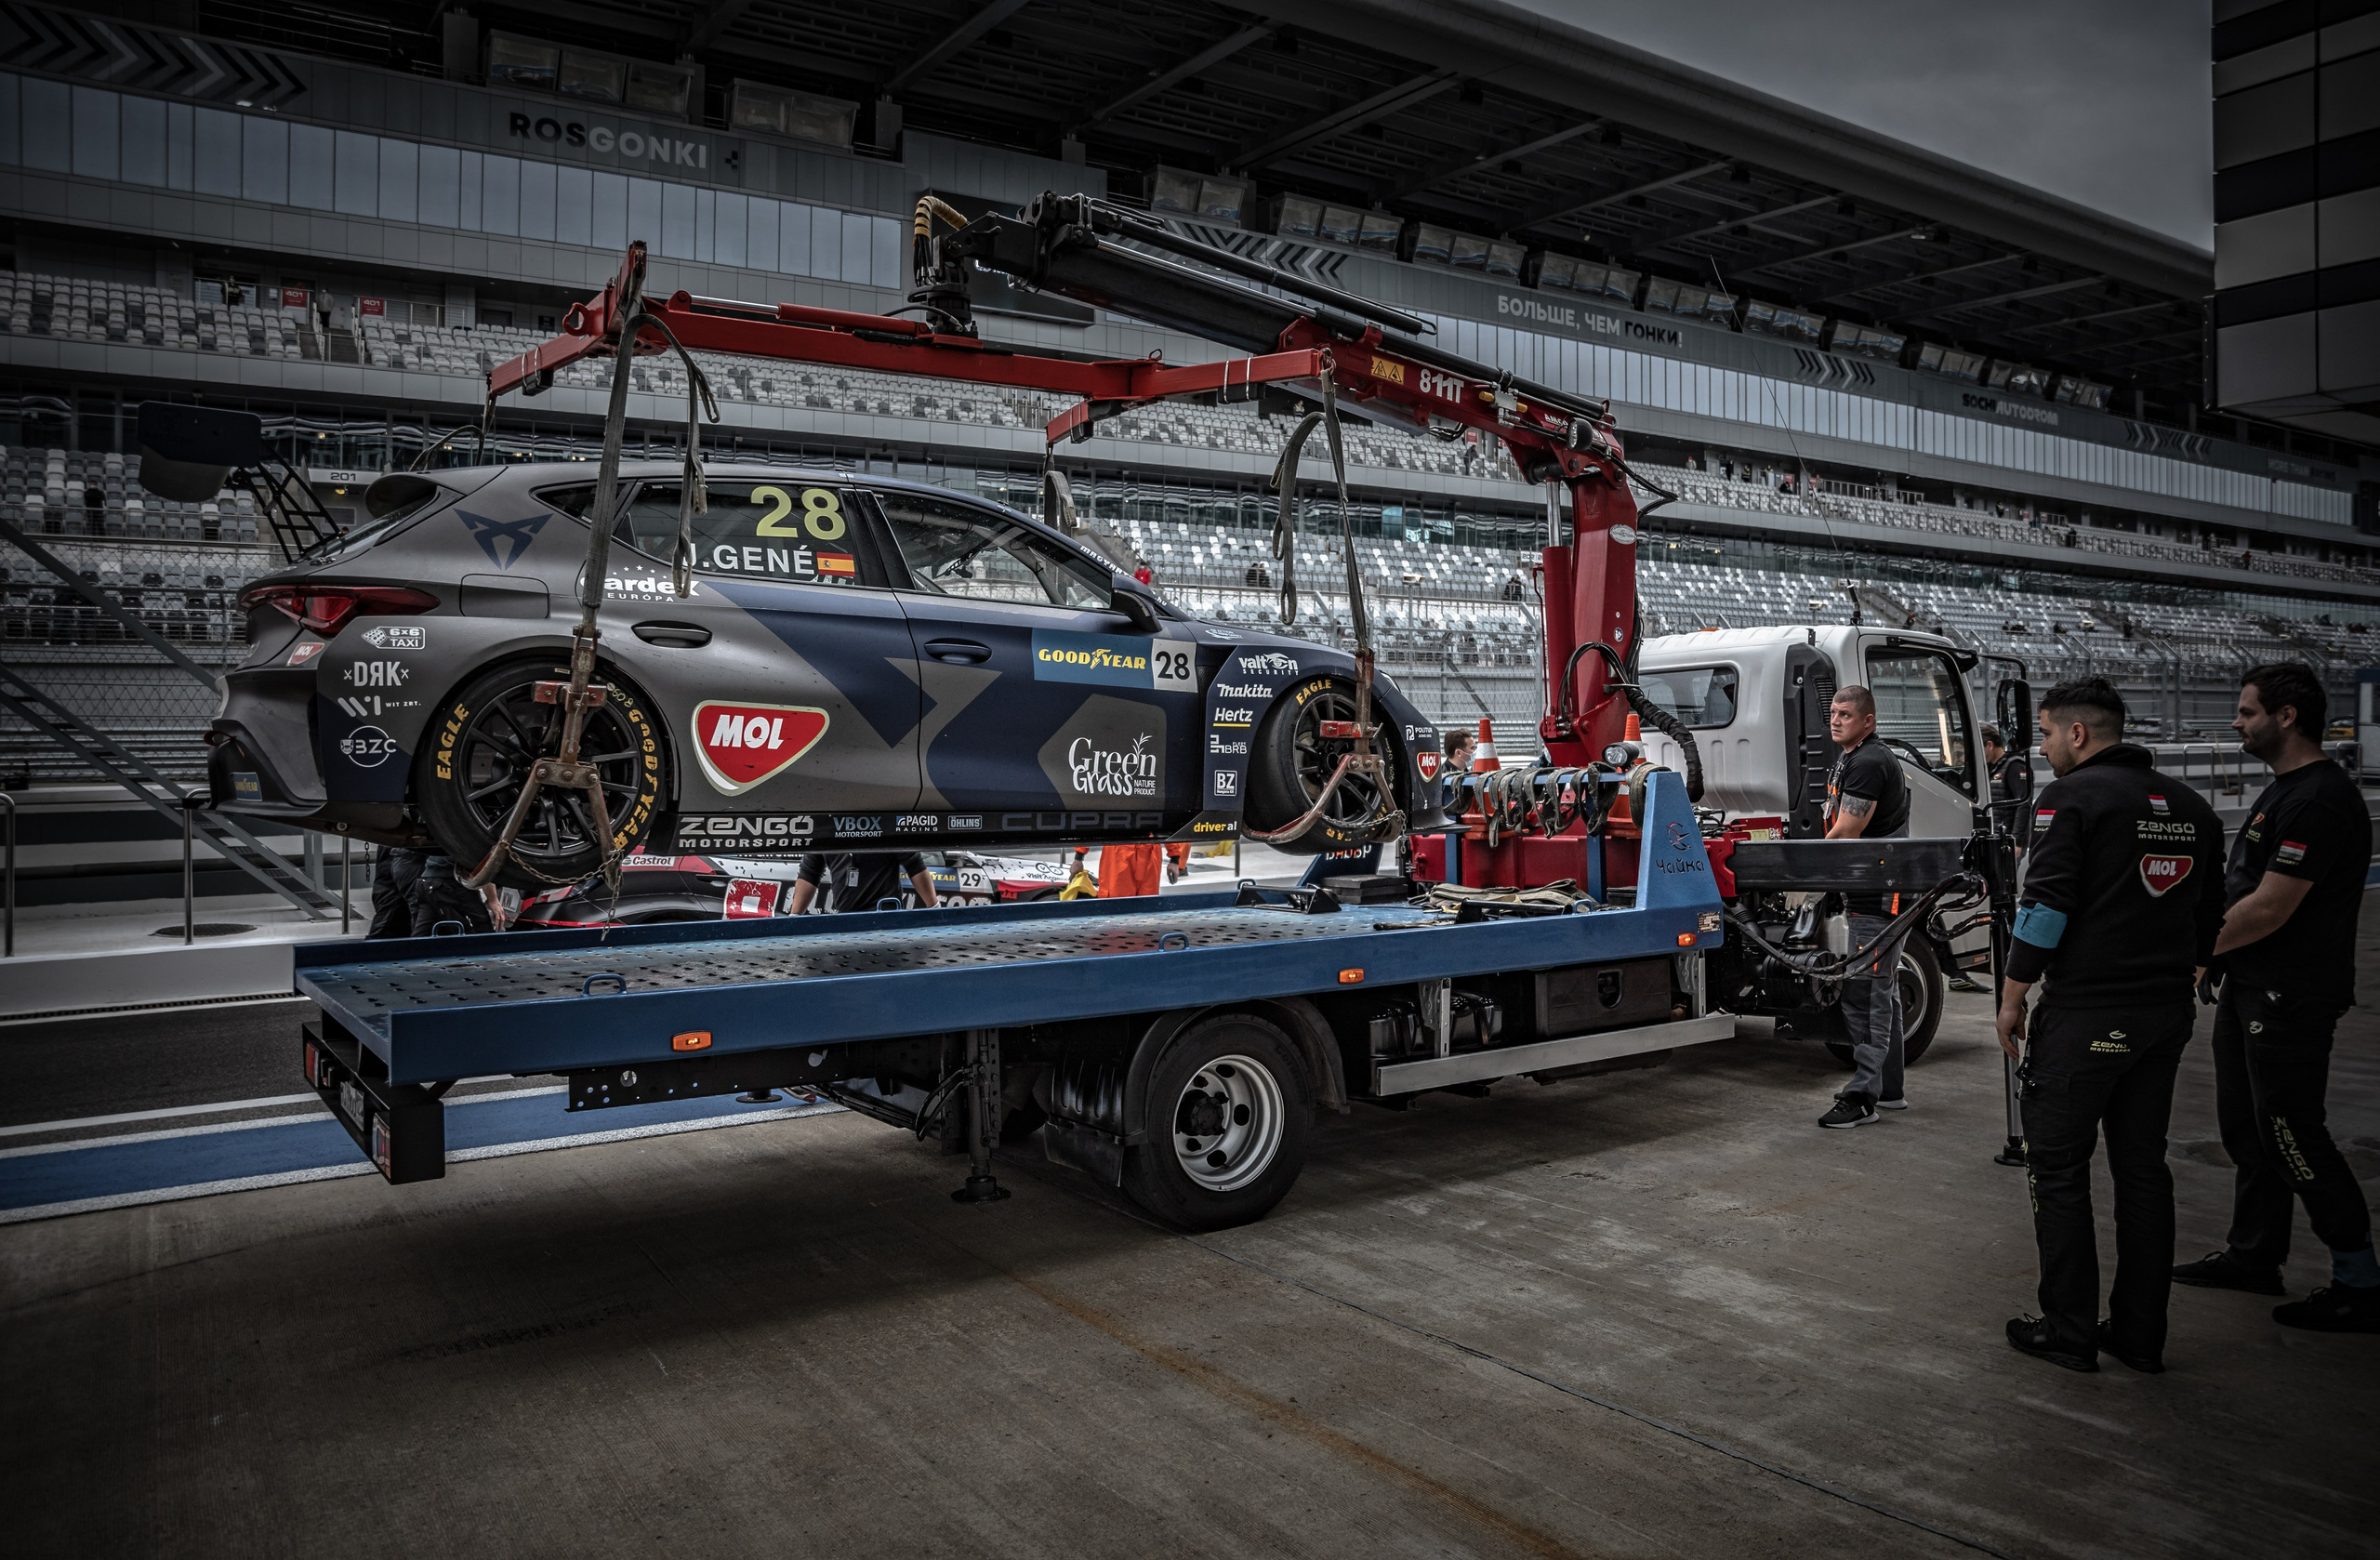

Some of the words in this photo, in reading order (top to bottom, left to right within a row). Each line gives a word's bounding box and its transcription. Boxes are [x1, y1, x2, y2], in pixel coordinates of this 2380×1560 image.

[509, 112, 707, 169] ROSGONKI
[285, 290, 304, 299] 401
[364, 298, 381, 308] 401
[1498, 295, 1580, 330] БОЛЬШЕ,
[1584, 311, 1620, 336] ЧЕМ
[1419, 368, 1464, 403] 811T
[330, 472, 356, 481] 201
[750, 485, 846, 540] 28
[295, 645, 314, 656] MOL
[1038, 648, 1146, 669] GOODYEAR
[1155, 651, 1190, 681] 28
[1296, 679, 1332, 706] EAGLE
[1214, 707, 1253, 722] Hertz
[709, 714, 784, 750] MOL
[437, 703, 469, 780] EAGLE
[1224, 745, 1248, 754] BRB
[1068, 736, 1157, 778] Green
[1421, 755, 1436, 767] MOL
[615, 708, 658, 850] GOODYEAR
[1073, 764, 1133, 796] Grass
[1134, 779, 1157, 788] NATURE
[1216, 773, 1236, 789] BZ
[833, 816, 881, 831] VBOX
[906, 815, 938, 826] PAGID
[1002, 813, 1163, 831] CUPRA
[679, 838, 813, 848] MOTORSPORT
[2138, 833, 2196, 841] MOTORSPORT
[632, 856, 672, 866] Castrol
[1656, 858, 1705, 875] Чайка
[2148, 860, 2177, 877] MOL
[960, 872, 982, 888] 29
